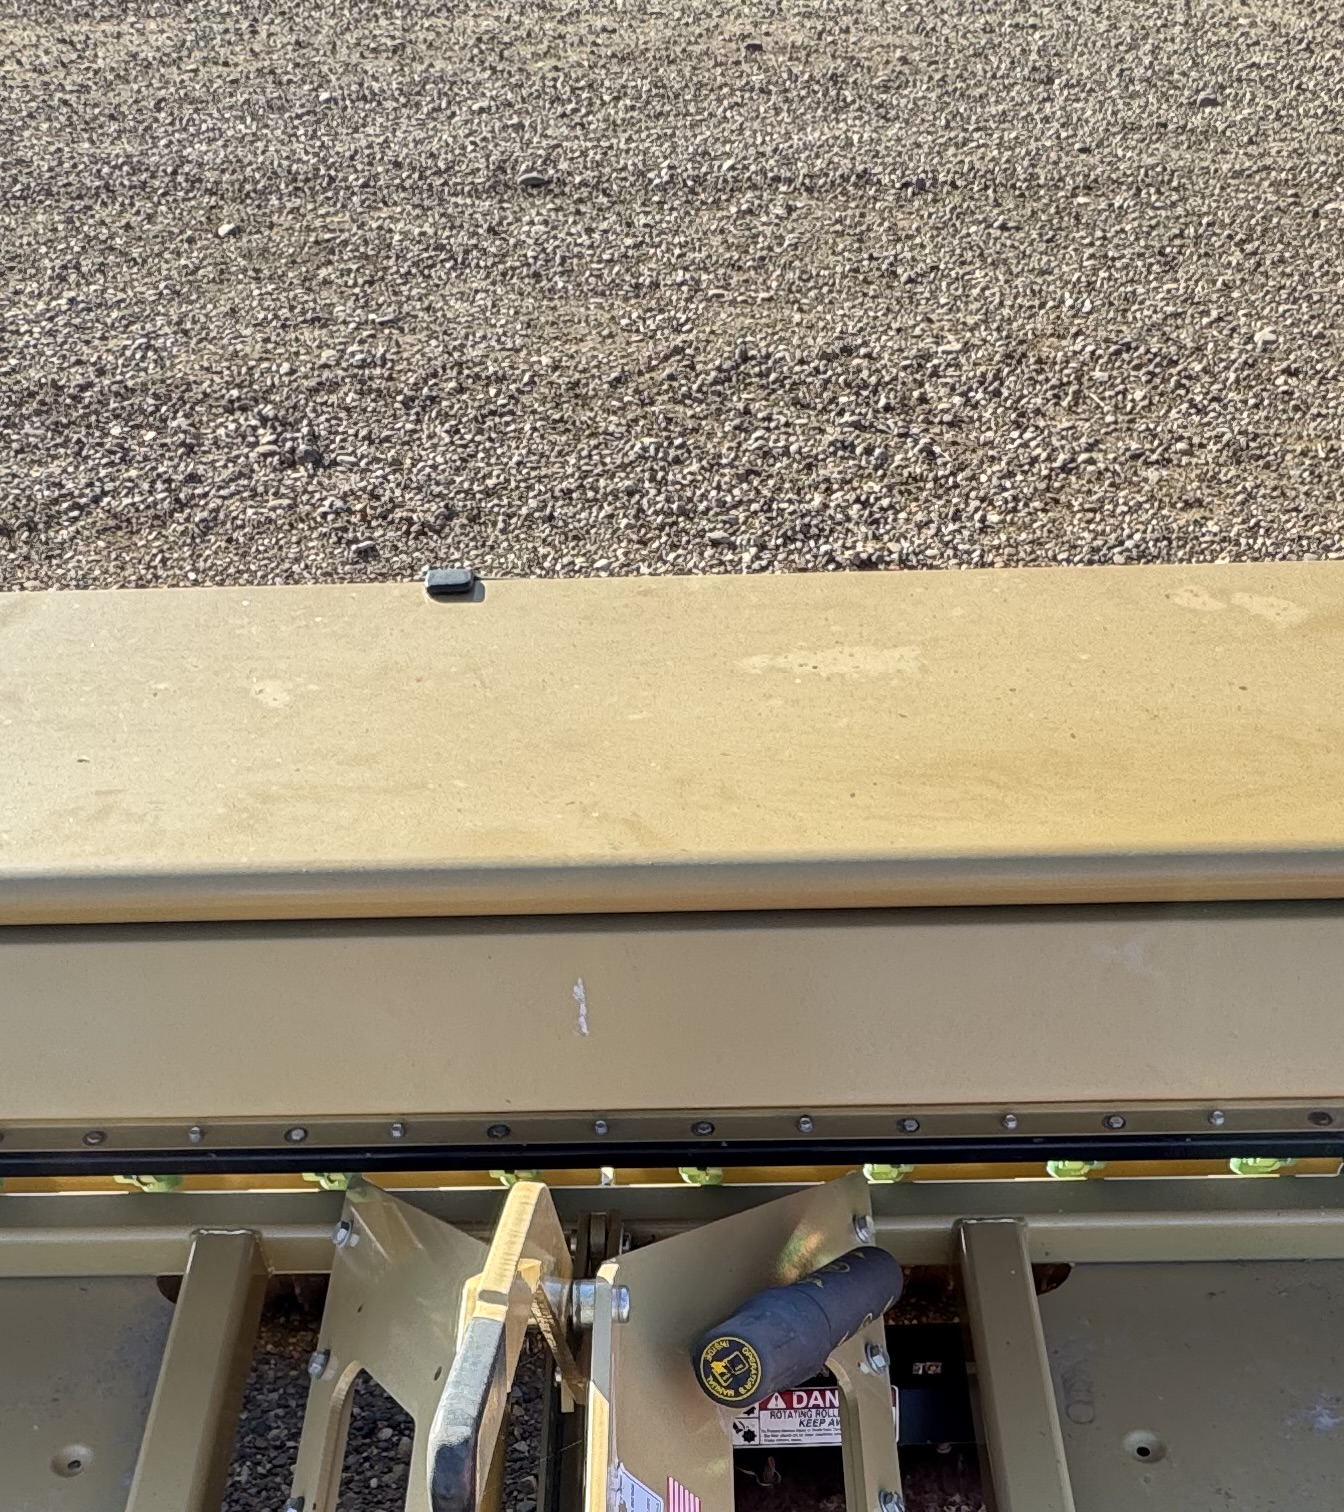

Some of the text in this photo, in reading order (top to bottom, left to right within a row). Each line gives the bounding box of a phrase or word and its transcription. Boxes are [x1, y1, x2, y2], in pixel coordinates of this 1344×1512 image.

[792, 1389, 840, 1409] DAN
[769, 1408, 840, 1420] ROTATING ROLL
[798, 1418, 826, 1428] KEEP
